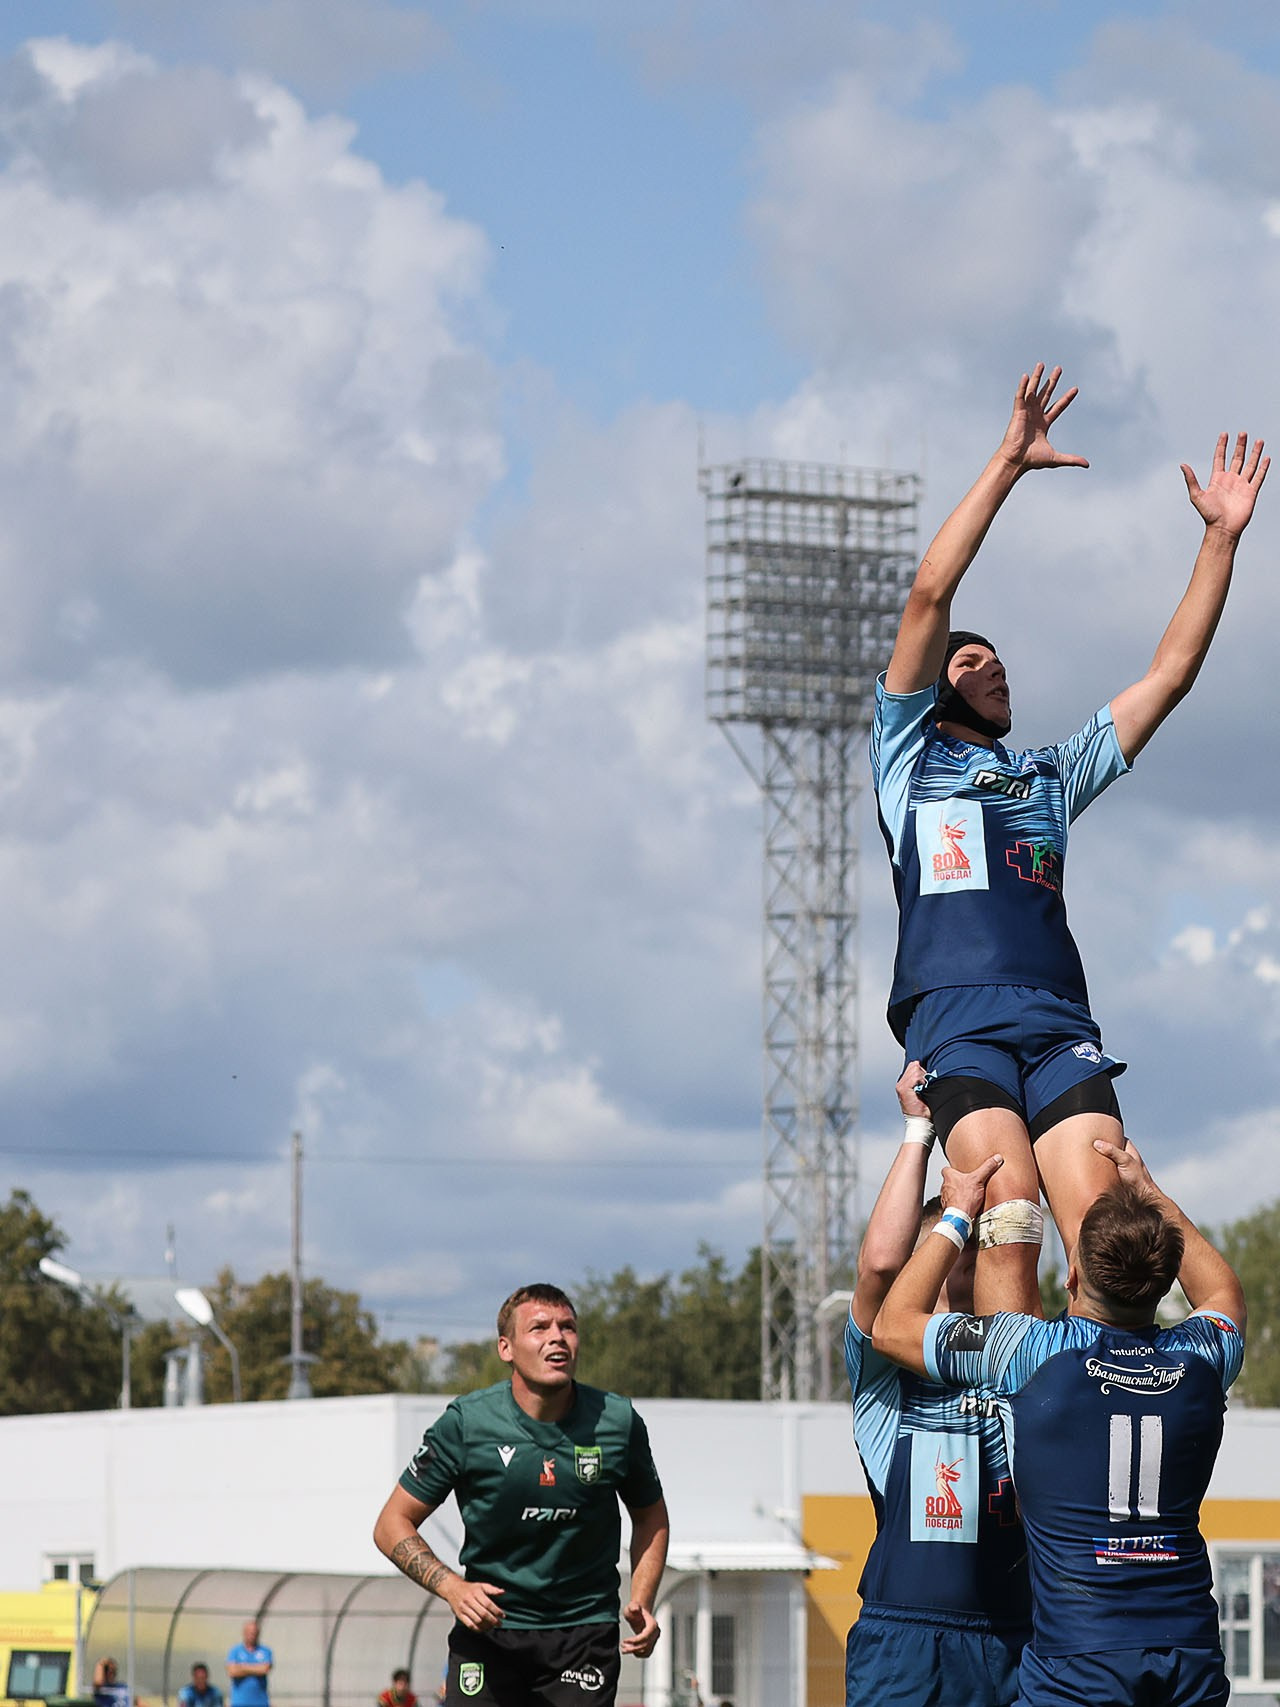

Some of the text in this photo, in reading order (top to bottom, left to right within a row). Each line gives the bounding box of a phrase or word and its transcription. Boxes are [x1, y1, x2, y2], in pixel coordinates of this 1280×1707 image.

[973, 770, 1030, 799] PARI
[932, 852, 953, 870] 80
[933, 870, 972, 881] ПОБЕДА!
[1108, 1414, 1162, 1522] 11
[926, 1496, 948, 1516] 80
[521, 1508, 577, 1521] PARI
[925, 1518, 963, 1529] ПОБЕДА!
[1108, 1536, 1164, 1550] ВГТРК
